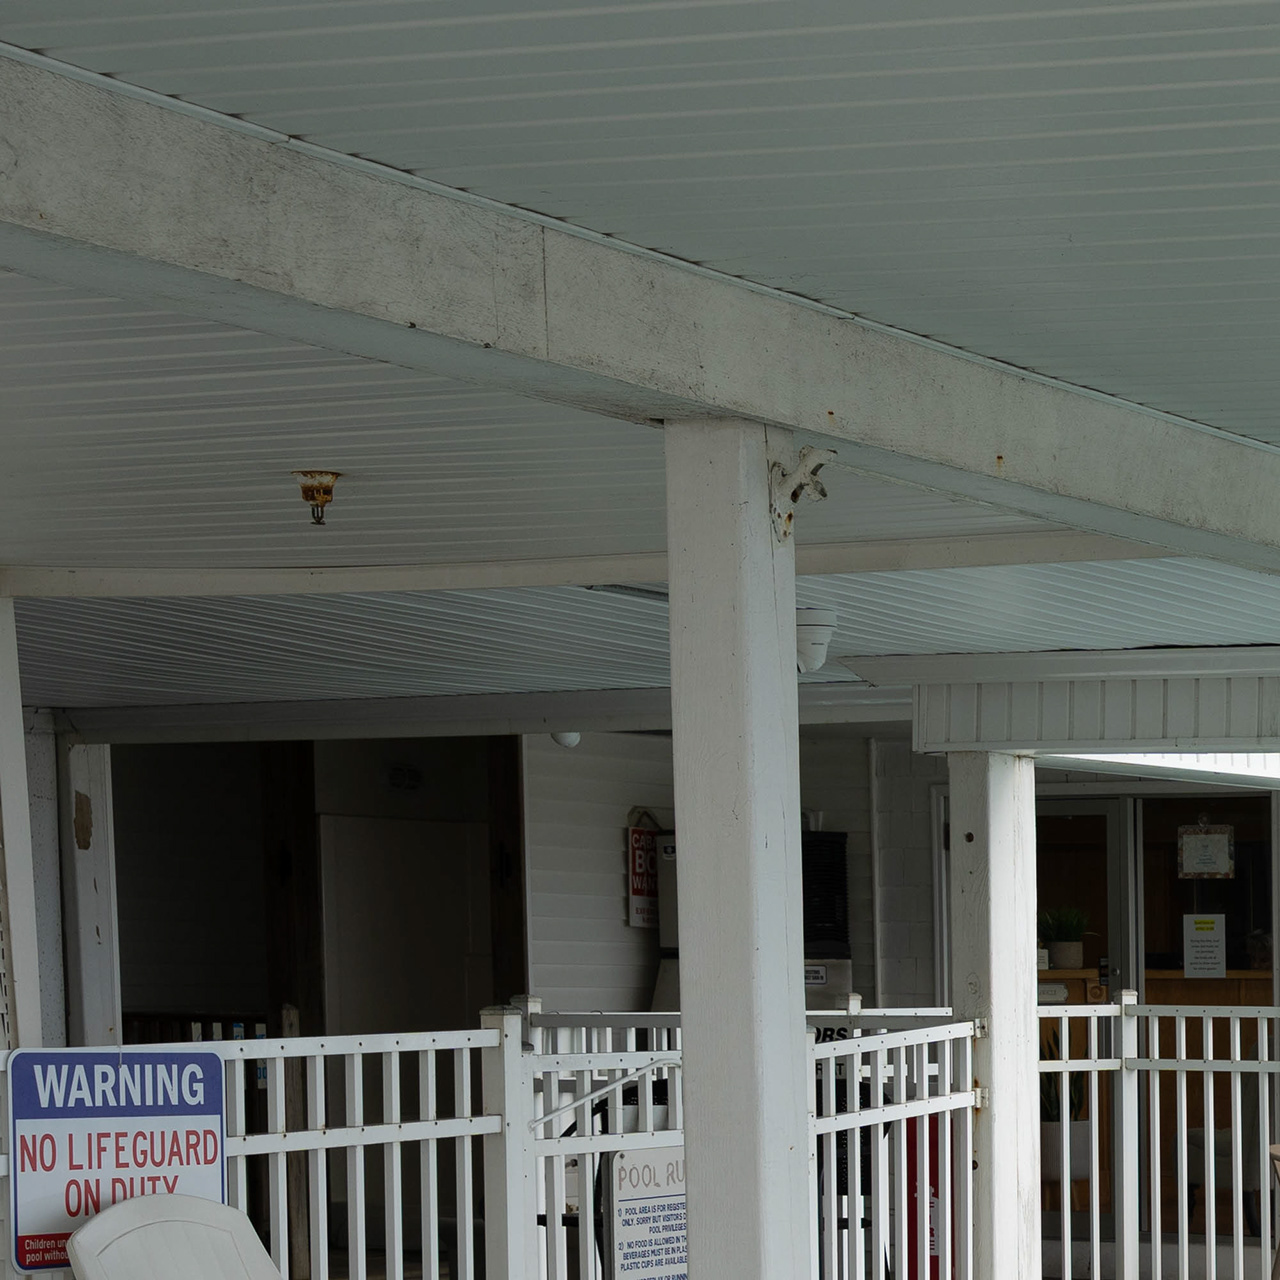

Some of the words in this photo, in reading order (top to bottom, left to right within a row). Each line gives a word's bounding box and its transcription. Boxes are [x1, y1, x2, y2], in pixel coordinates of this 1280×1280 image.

[33, 1063, 204, 1108] WARNING
[20, 1134, 57, 1172] NO
[68, 1129, 218, 1170] LIFEGUARD
[618, 1164, 661, 1191] POOL
[65, 1178, 100, 1218] ON
[625, 1207, 637, 1215] POOL
[639, 1206, 650, 1214] AREA
[657, 1204, 666, 1212] FOR
[667, 1202, 686, 1211] REGISTE
[636, 1216, 650, 1225] SORRY
[652, 1215, 661, 1223] BUT
[662, 1212, 682, 1222] VISITORS
[649, 1225, 661, 1234] POOL
[25, 1238, 55, 1250] Children
[627, 1240, 634, 1249] NO
[635, 1239, 647, 1248] FOOD
[654, 1236, 675, 1246] ALLOWED
[26, 1252, 42, 1264] pool
[44, 1250, 70, 1261] withou
[623, 1250, 650, 1260] BEVERAGES
[651, 1248, 663, 1257] MUST
[676, 1245, 687, 1253] PLAS
[620, 1261, 640, 1271] PLASTIC
[641, 1259, 654, 1269] CUPS
[655, 1258, 664, 1267] ARE
